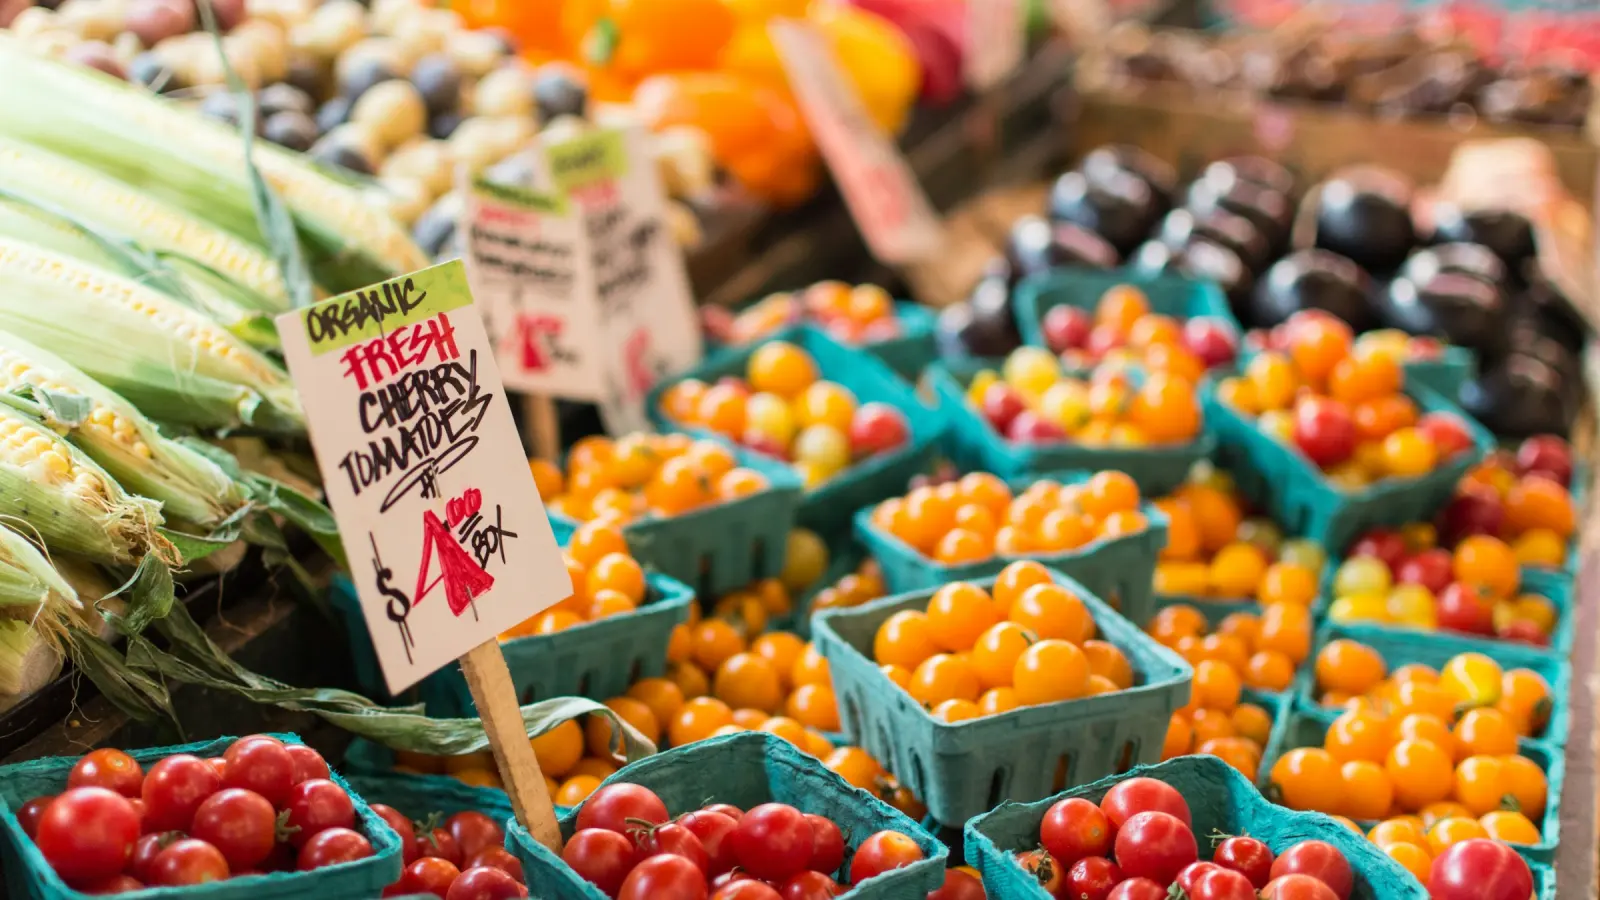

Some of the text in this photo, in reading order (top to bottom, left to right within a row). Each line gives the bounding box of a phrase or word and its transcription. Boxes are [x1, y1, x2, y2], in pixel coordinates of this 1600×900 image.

[307, 278, 426, 343] ORGANIC
[340, 312, 460, 390] FRESH
[359, 348, 481, 434] CHERRY
[339, 392, 493, 495] TOMATOES
[472, 504, 518, 569] BOX
